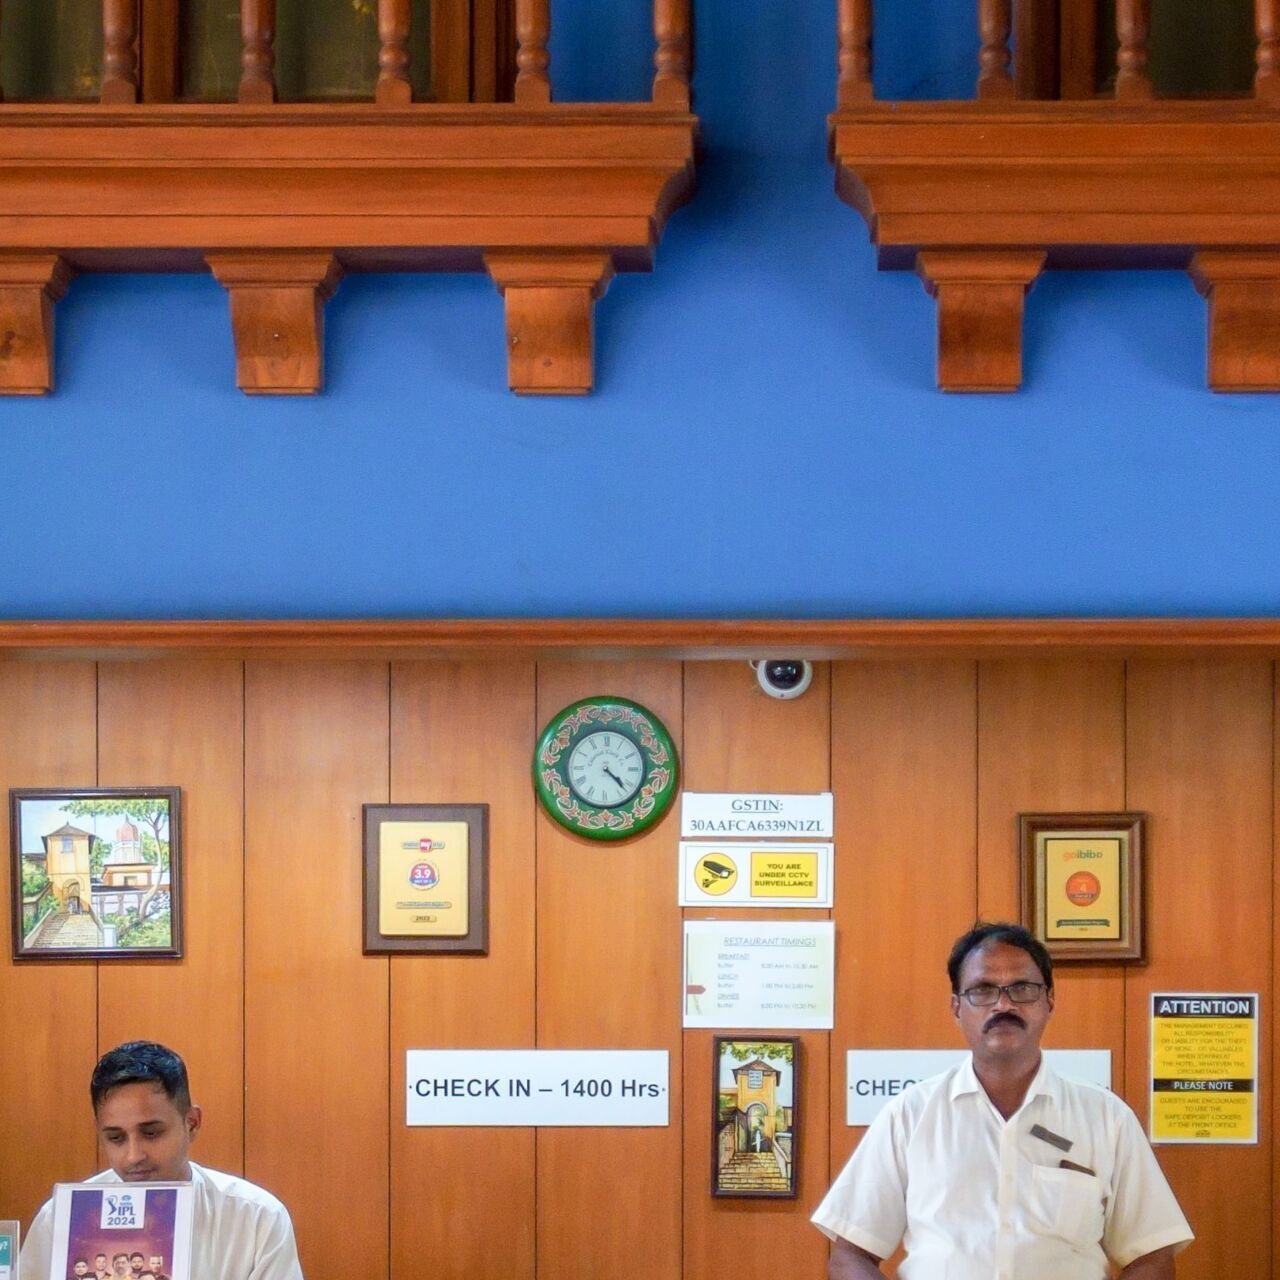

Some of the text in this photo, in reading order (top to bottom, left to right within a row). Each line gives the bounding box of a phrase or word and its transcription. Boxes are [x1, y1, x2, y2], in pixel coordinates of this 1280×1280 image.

[731, 799, 783, 811] GSTIN:
[690, 819, 824, 832] 30AAFCA6339N1ZL
[415, 869, 431, 878] 3.9
[1160, 1001, 1250, 1014] ATTENTION
[415, 1079, 500, 1097] CHECK
[509, 1079, 531, 1097] IN
[561, 1079, 613, 1097] 1400
[621, 1079, 660, 1097] Hrs
[856, 1080, 923, 1096] CHEC
[1174, 1081, 1233, 1090] PLEASE NOTE
[118, 1206, 136, 1216] IPL
[107, 1216, 135, 1226] 2024
